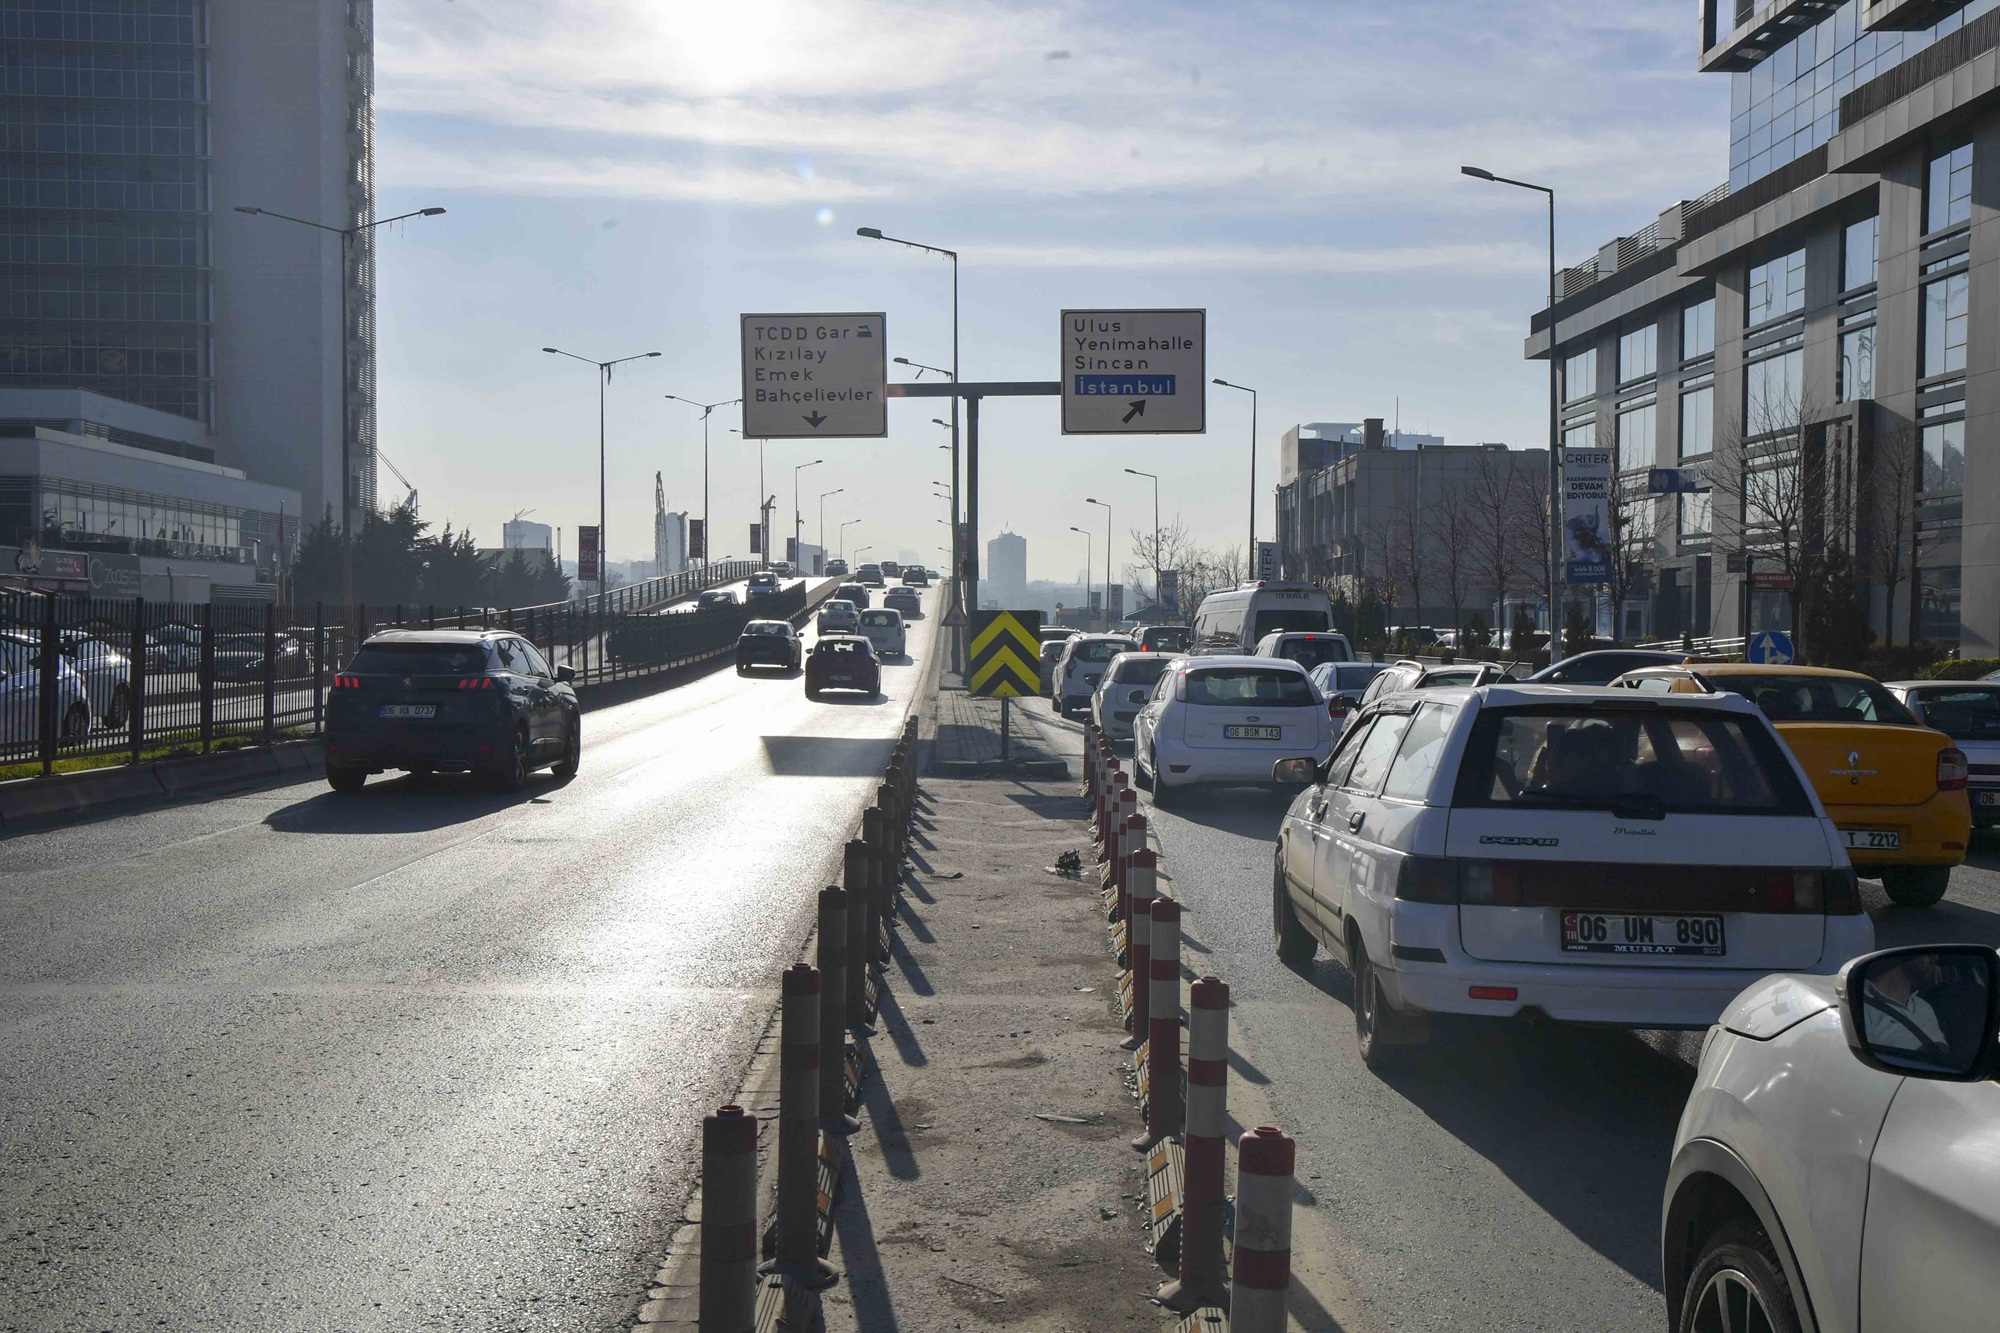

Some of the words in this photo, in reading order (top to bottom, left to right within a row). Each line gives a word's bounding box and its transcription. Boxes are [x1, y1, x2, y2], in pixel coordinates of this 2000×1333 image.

[754, 327, 808, 341] TCDD
[816, 325, 850, 340] Gar
[1074, 319, 1122, 333] Ulus
[1074, 337, 1193, 351] Yenimahalle
[754, 346, 827, 363] Kızılay
[1074, 355, 1149, 370] Sincan
[755, 368, 813, 381] Emek
[1078, 377, 1173, 395] İstanbul
[755, 388, 873, 404] Bahçelievler
[1566, 454, 1609, 463] CRITER
[580, 551, 596, 561] 50
[385, 706, 395, 714] 06
[1230, 728, 1240, 736] 06
[1244, 728, 1259, 737] BSM
[1265, 729, 1279, 738] 143
[1982, 793, 1995, 804] 06
[1847, 832, 1856, 846] T
[1869, 833, 1899, 847] 2212
[1566, 931, 1577, 940] TR
[1579, 916, 1607, 941] 06
[1625, 917, 1654, 943] UM
[1677, 919, 1719, 944] 890
